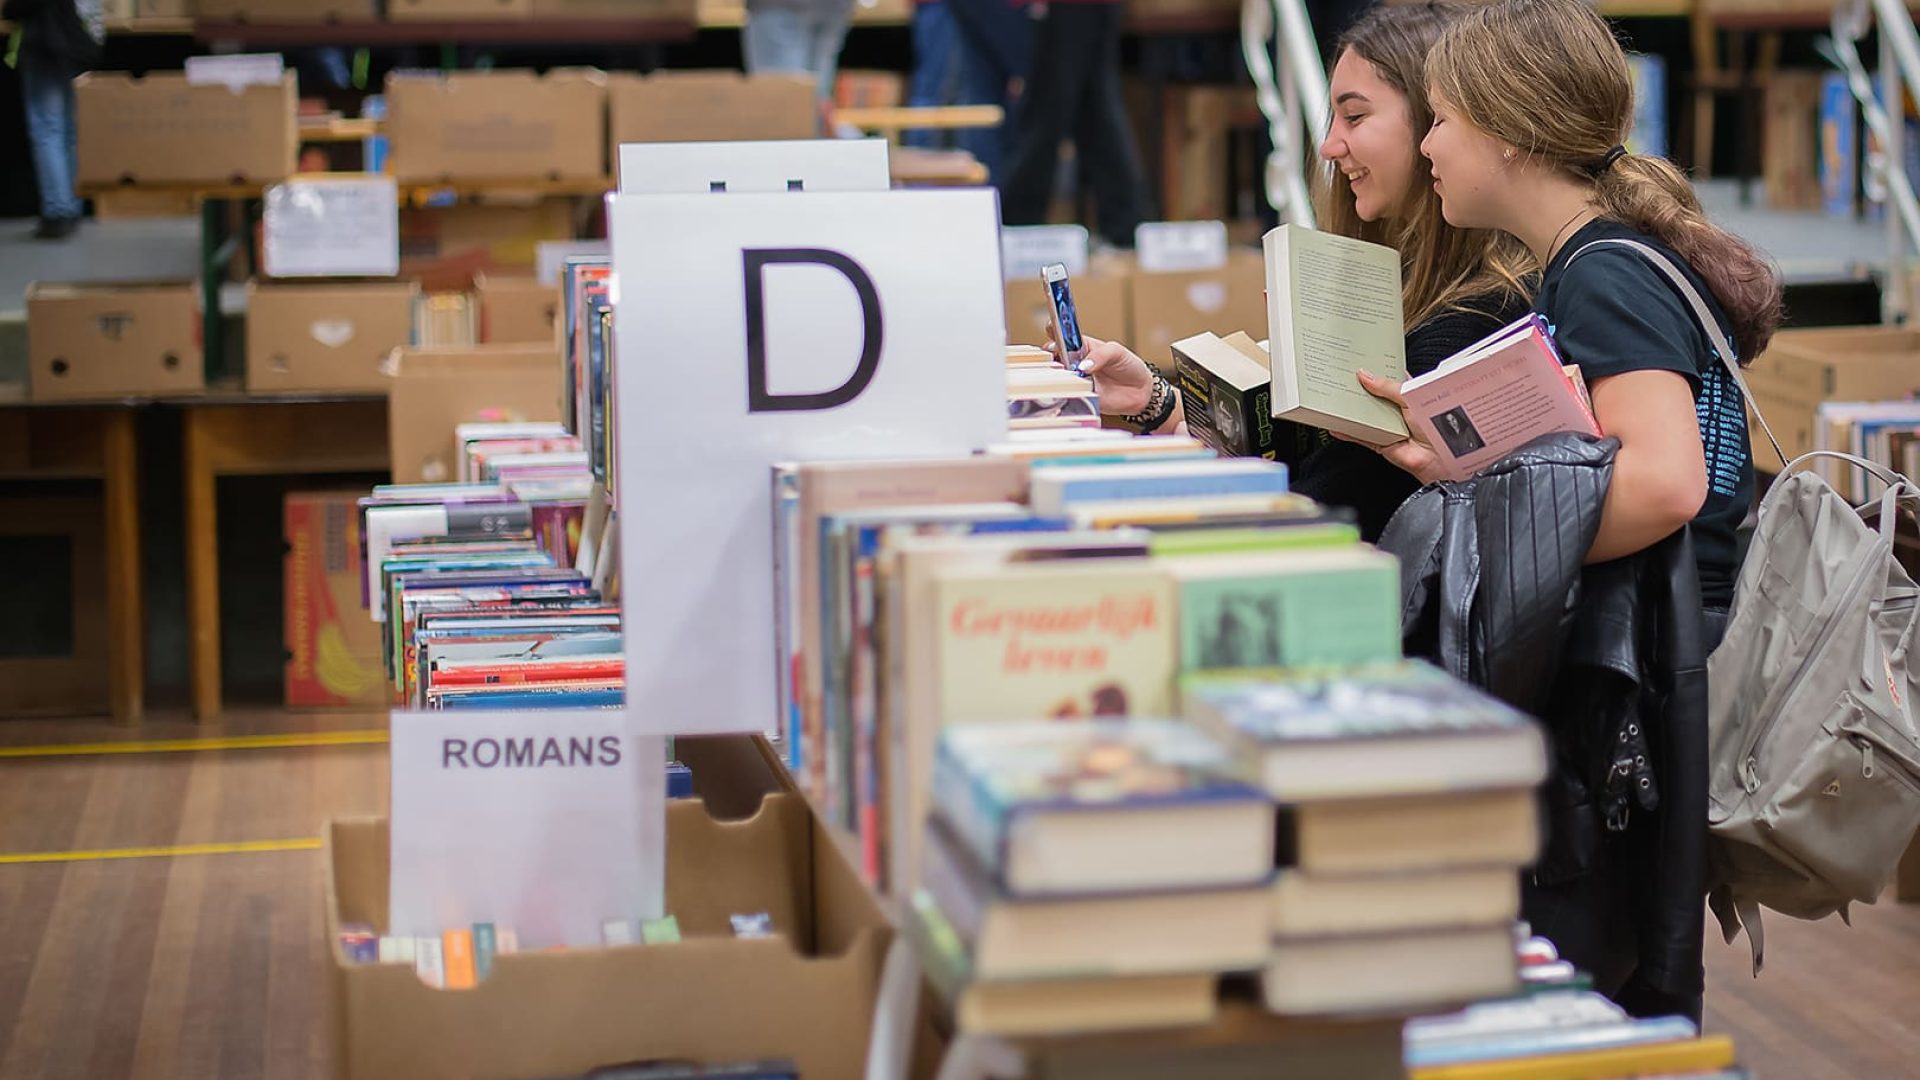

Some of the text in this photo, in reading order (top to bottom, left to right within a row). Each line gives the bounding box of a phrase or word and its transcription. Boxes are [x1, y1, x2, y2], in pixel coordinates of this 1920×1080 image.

[742, 247, 885, 415] D
[949, 591, 1159, 644] Gevaarlijk
[1003, 637, 1109, 675] leven
[442, 735, 622, 769] ROMANS
